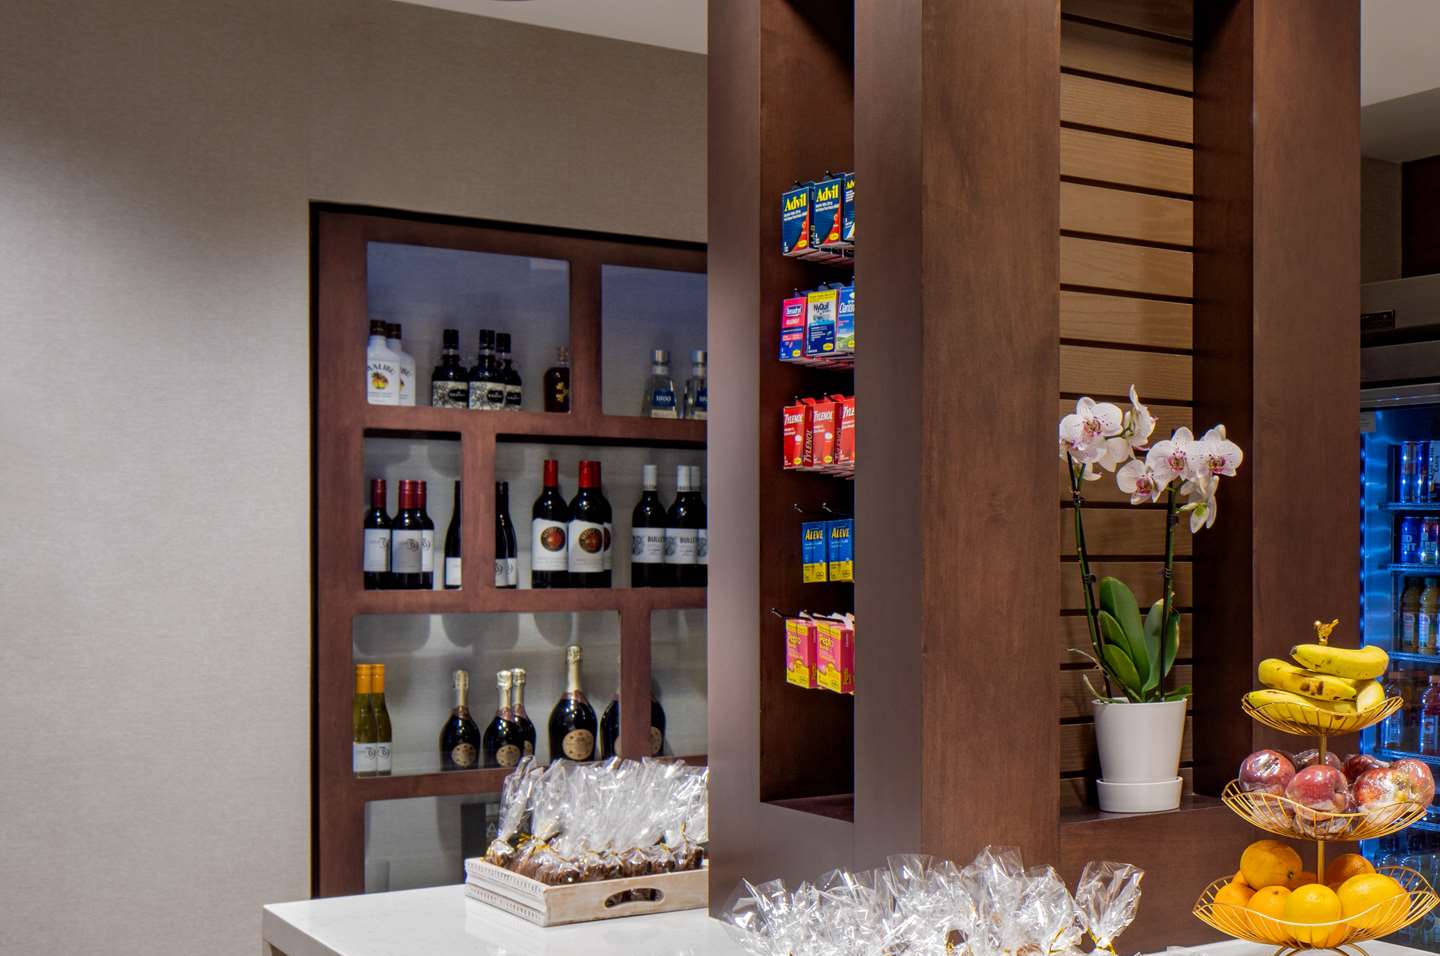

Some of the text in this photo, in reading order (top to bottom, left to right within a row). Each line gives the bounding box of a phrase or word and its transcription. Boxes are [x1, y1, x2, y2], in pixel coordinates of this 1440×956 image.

[784, 192, 807, 212] Advil
[816, 184, 839, 202] Advil
[803, 430, 813, 463] TYLENOL
[805, 528, 823, 540] ALEVE
